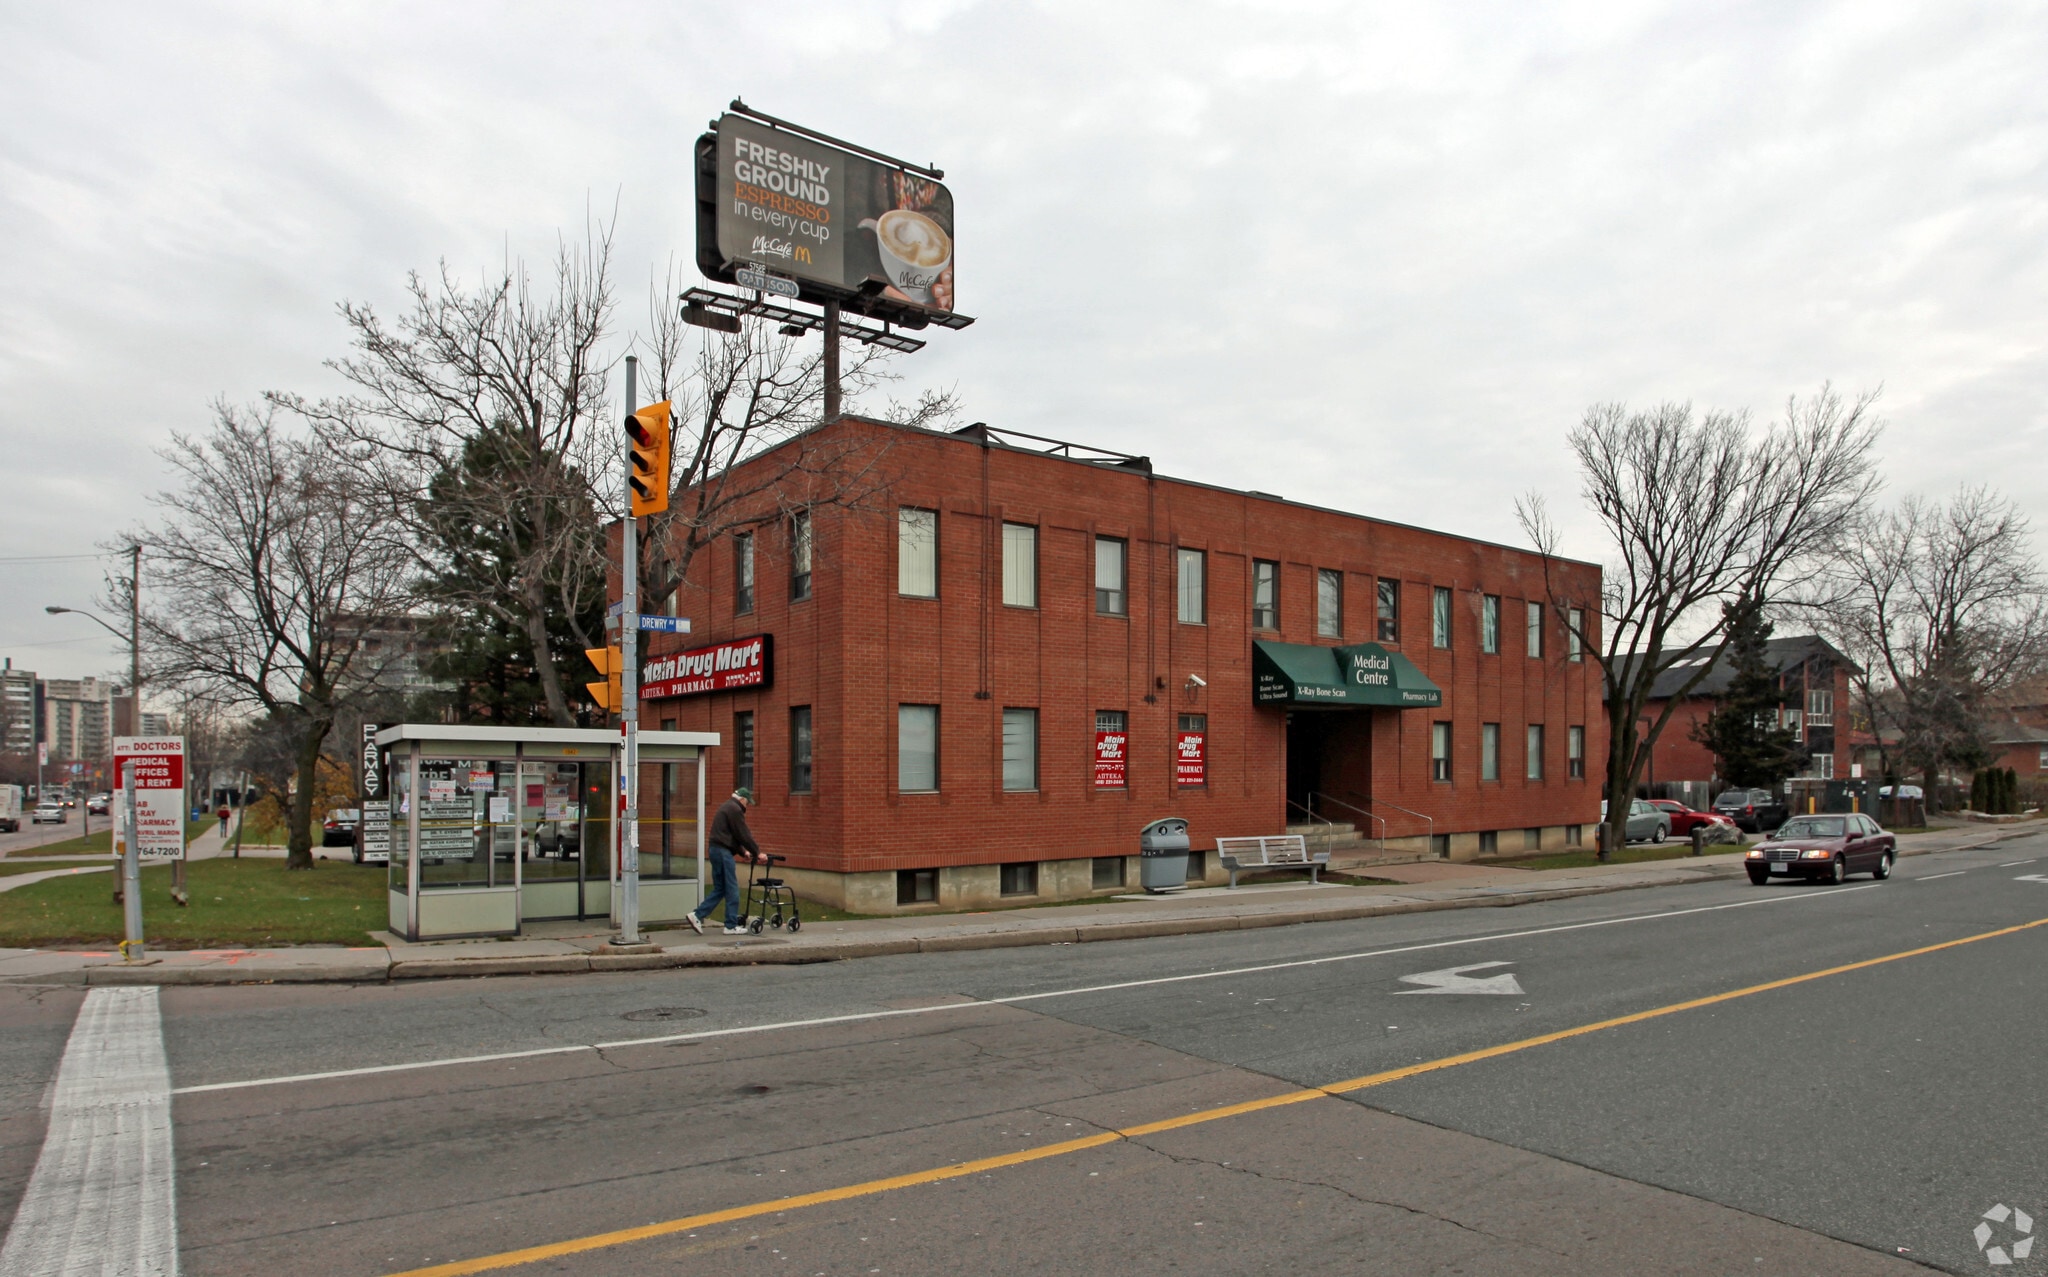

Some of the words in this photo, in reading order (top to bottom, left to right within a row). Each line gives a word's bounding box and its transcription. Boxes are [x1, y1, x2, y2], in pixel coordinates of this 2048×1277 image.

[735, 137, 831, 184] FRESHLY
[734, 160, 830, 206] GROUND
[735, 181, 831, 224] ESPRESSO
[734, 198, 748, 217] in
[751, 206, 798, 236] every
[800, 220, 830, 245] cup
[641, 617, 668, 629] DREWRY
[676, 653, 714, 678] Drug
[715, 641, 760, 672] Mart
[1353, 654, 1389, 670] Medical
[1356, 669, 1389, 686] Centre
[672, 678, 715, 695] PHARMACY
[1297, 686, 1316, 698] X-Ray
[1316, 687, 1332, 697] Bone
[1332, 688, 1346, 697] Scan
[1402, 691, 1427, 702] Pharmacy
[1428, 692, 1438, 701] Lab
[1104, 735, 1125, 744] Main
[1184, 735, 1203, 744] Main
[133, 742, 182, 751] DOCTORS
[1097, 742, 1118, 751] Drug
[1178, 742, 1197, 751] Drug
[1101, 750, 1122, 758] Mart
[1182, 749, 1201, 757] Mart
[135, 767, 169, 777] FFICES
[147, 778, 173, 787] RENT
